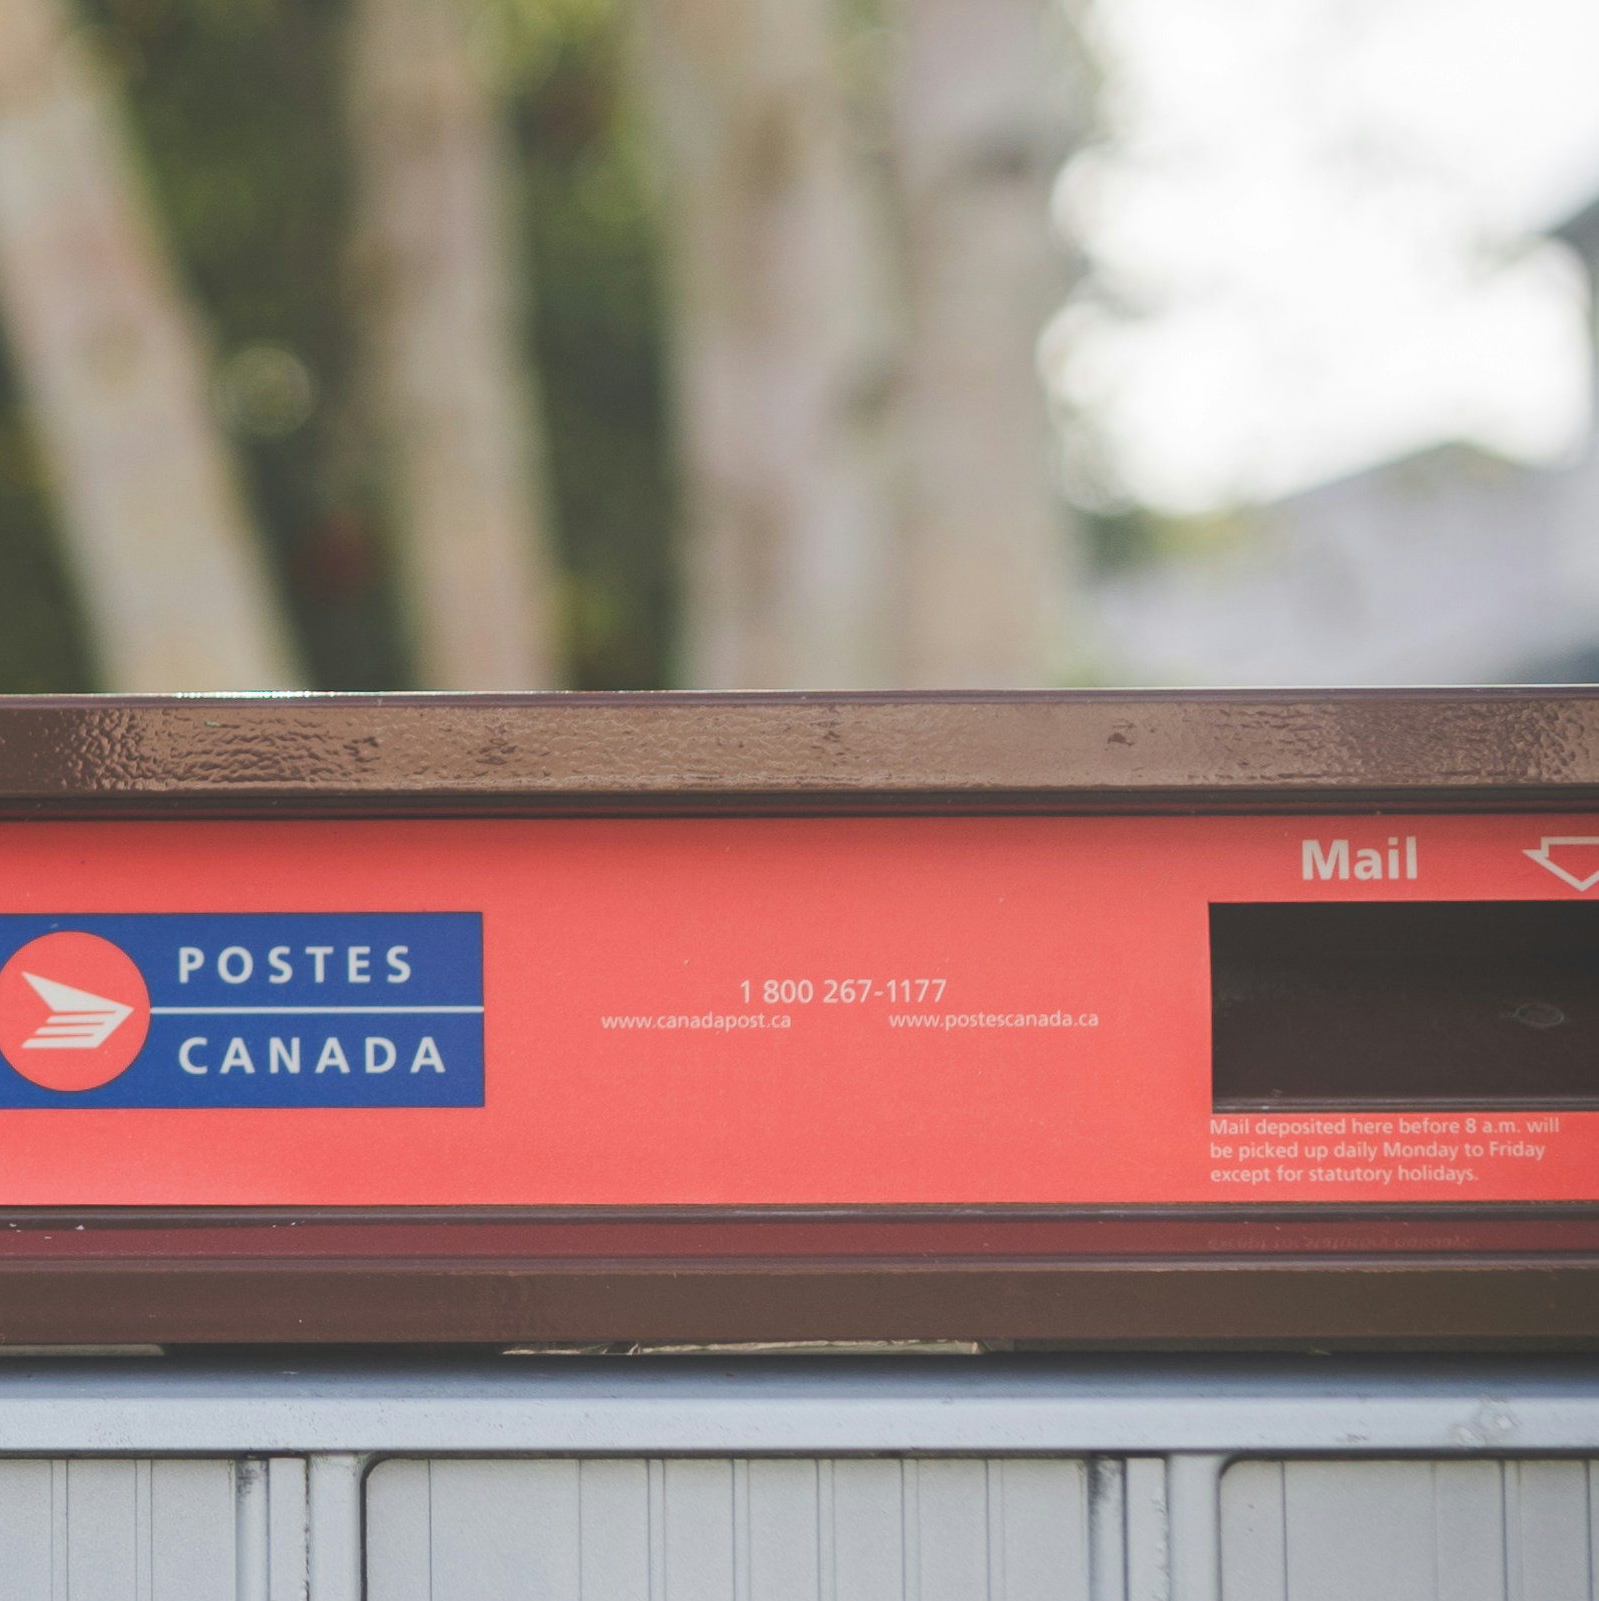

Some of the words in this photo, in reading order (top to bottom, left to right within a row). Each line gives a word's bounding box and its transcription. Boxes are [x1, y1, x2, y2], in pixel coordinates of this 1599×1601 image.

[1302, 836, 1418, 881] Mail
[178, 945, 411, 984] POSTES
[740, 979, 750, 1004] 1
[763, 979, 814, 1004] 800
[823, 978, 947, 1004] 267-1177
[601, 1011, 792, 1032] www.canadapost.ca
[888, 1009, 1099, 1031] www.postescanada.ca
[178, 1036, 446, 1075] CANADA
[1209, 1118, 1250, 1135] Mail
[1254, 1118, 1346, 1138] deposited
[1351, 1118, 1393, 1135] here
[1398, 1117, 1460, 1134] before
[1465, 1117, 1477, 1134] 8
[1481, 1121, 1521, 1134] a.m.
[1526, 1117, 1560, 1134] will
[1210, 1142, 1233, 1159] be
[1238, 1141, 1299, 1162] picked
[1304, 1145, 1329, 1162] up
[1333, 1141, 1378, 1162] daily
[1383, 1141, 1459, 1161] Monday
[1463, 1142, 1485, 1158] to
[1489, 1140, 1545, 1161] Friday
[1210, 1167, 1271, 1185] except
[1276, 1164, 1304, 1182] for
[1308, 1167, 1393, 1185] statutory
[1397, 1164, 1479, 1185] holidays.
